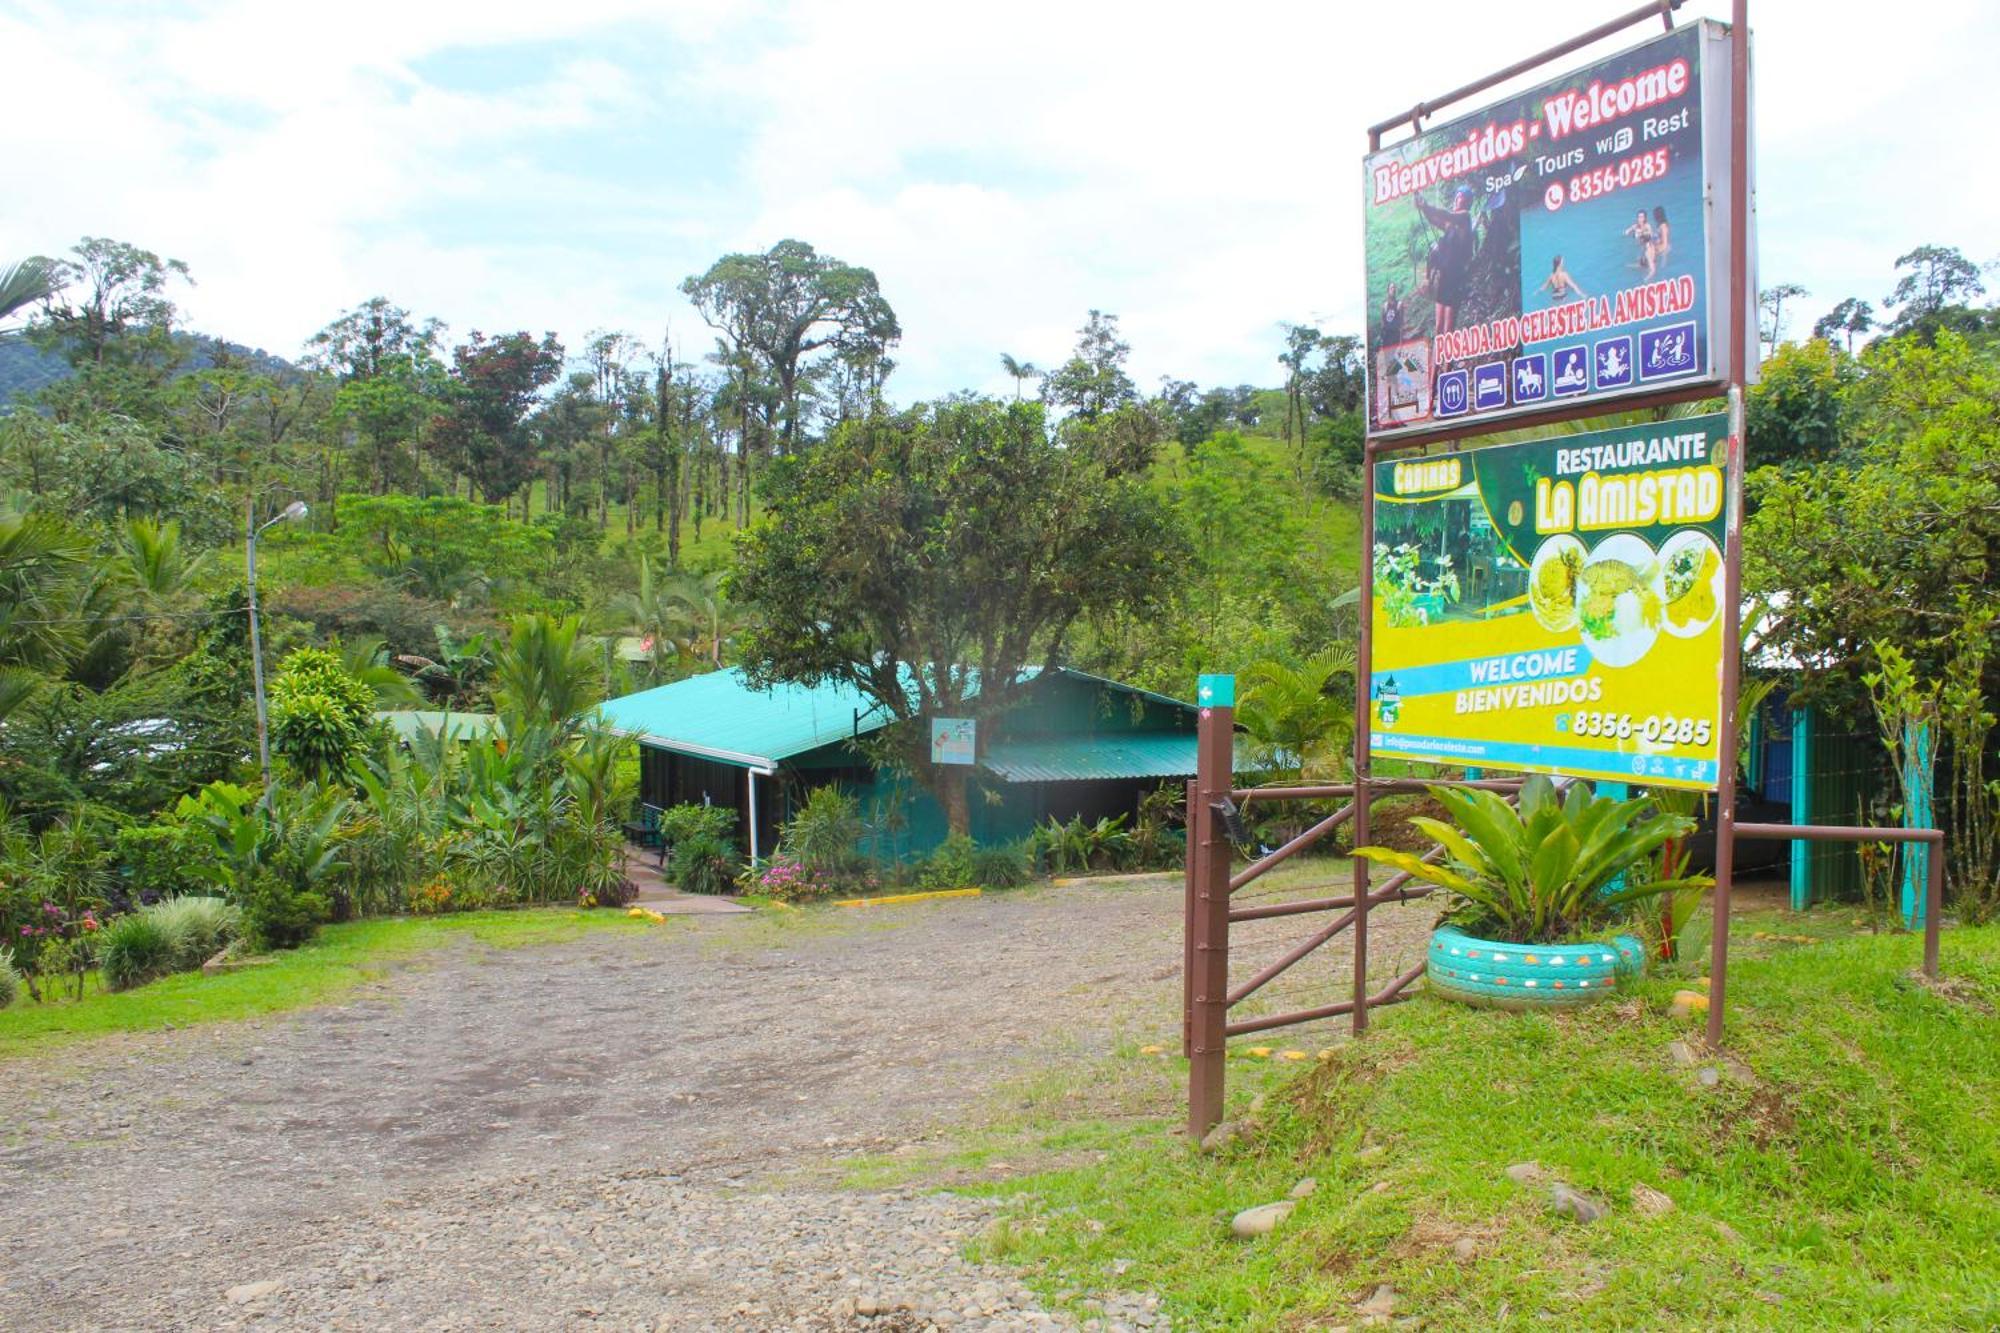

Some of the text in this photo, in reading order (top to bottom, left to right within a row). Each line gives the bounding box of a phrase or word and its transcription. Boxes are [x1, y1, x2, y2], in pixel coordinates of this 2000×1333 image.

[1374, 60, 1687, 203] Bienvenidos - Welcome
[1485, 174, 1512, 193] Spa
[1535, 147, 1605, 176] Tours
[1643, 107, 1689, 141] Rest
[1569, 149, 1667, 203] 8356-0285
[1435, 325, 1494, 365] POSADA
[1491, 317, 1519, 350] RIO
[1519, 301, 1586, 345] CELESTE
[1589, 296, 1611, 329] LA
[1615, 275, 1694, 323] AMISTAD
[1556, 432, 1707, 475] RESTAURANTE
[1538, 468, 1720, 531] LA AMISTAD
[1469, 649, 1578, 684] WELCOME
[1454, 677, 1603, 715] BIENVENIDOS
[1573, 711, 1712, 746] 8356-0285
